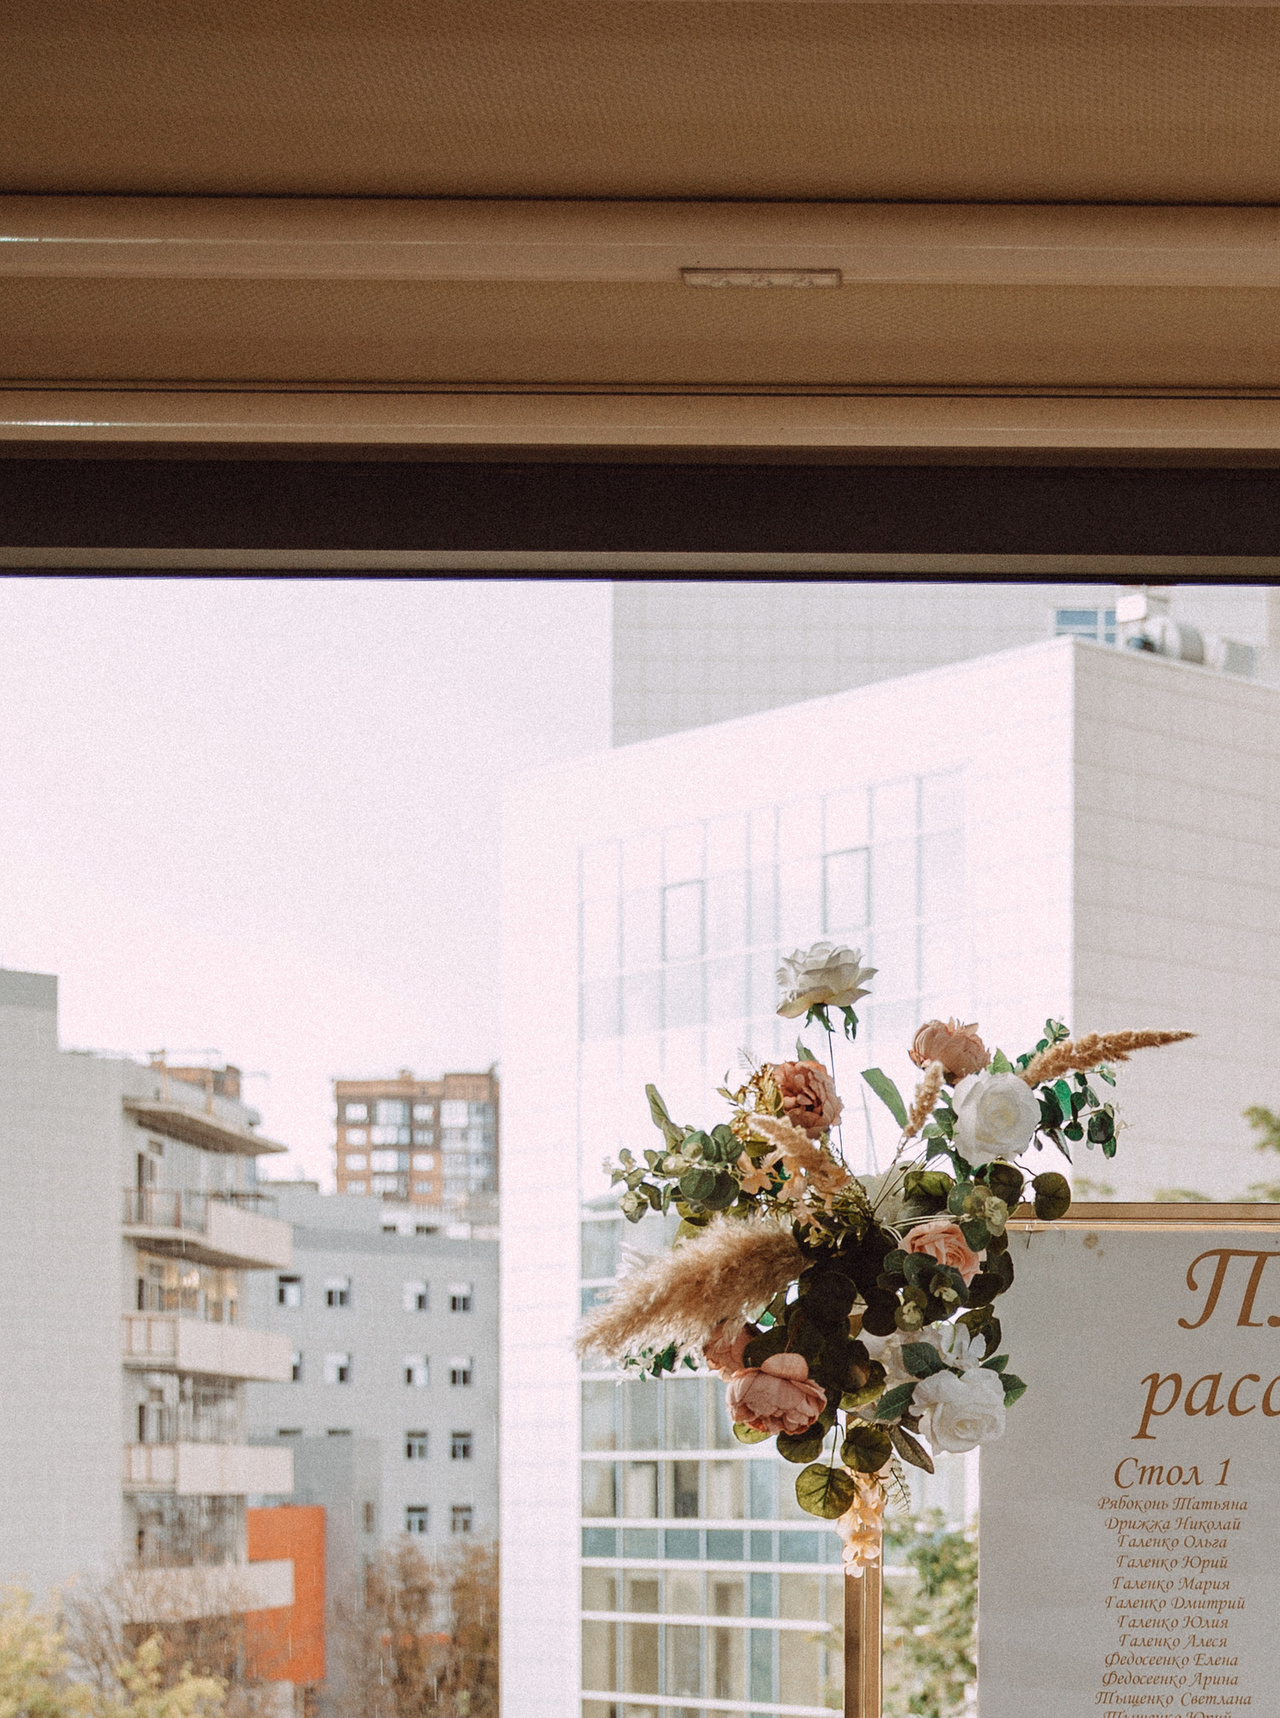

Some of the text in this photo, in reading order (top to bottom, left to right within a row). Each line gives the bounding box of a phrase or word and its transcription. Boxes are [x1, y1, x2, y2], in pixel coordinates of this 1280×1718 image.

[1114, 1457, 1230, 1489] Стол 1
[1098, 1495, 1247, 1511] Рябоконь Татьяна
[1105, 1518, 1240, 1534] Дрижжа Николай
[1118, 1535, 1227, 1550] Галенко Ольга
[1117, 1555, 1227, 1573] Галенко Юрий
[1113, 1577, 1230, 1594] Галенко Мария
[1105, 1596, 1245, 1614] Галенко Дмитрий
[1118, 1615, 1228, 1630] Галенко Юлия
[1119, 1634, 1227, 1649] Галенко Алеся
[1105, 1652, 1238, 1668] Федосеенко Елена
[1102, 1671, 1238, 1690] Федосеенко Арина
[1095, 1691, 1251, 1707] Тыщенко Светлана
